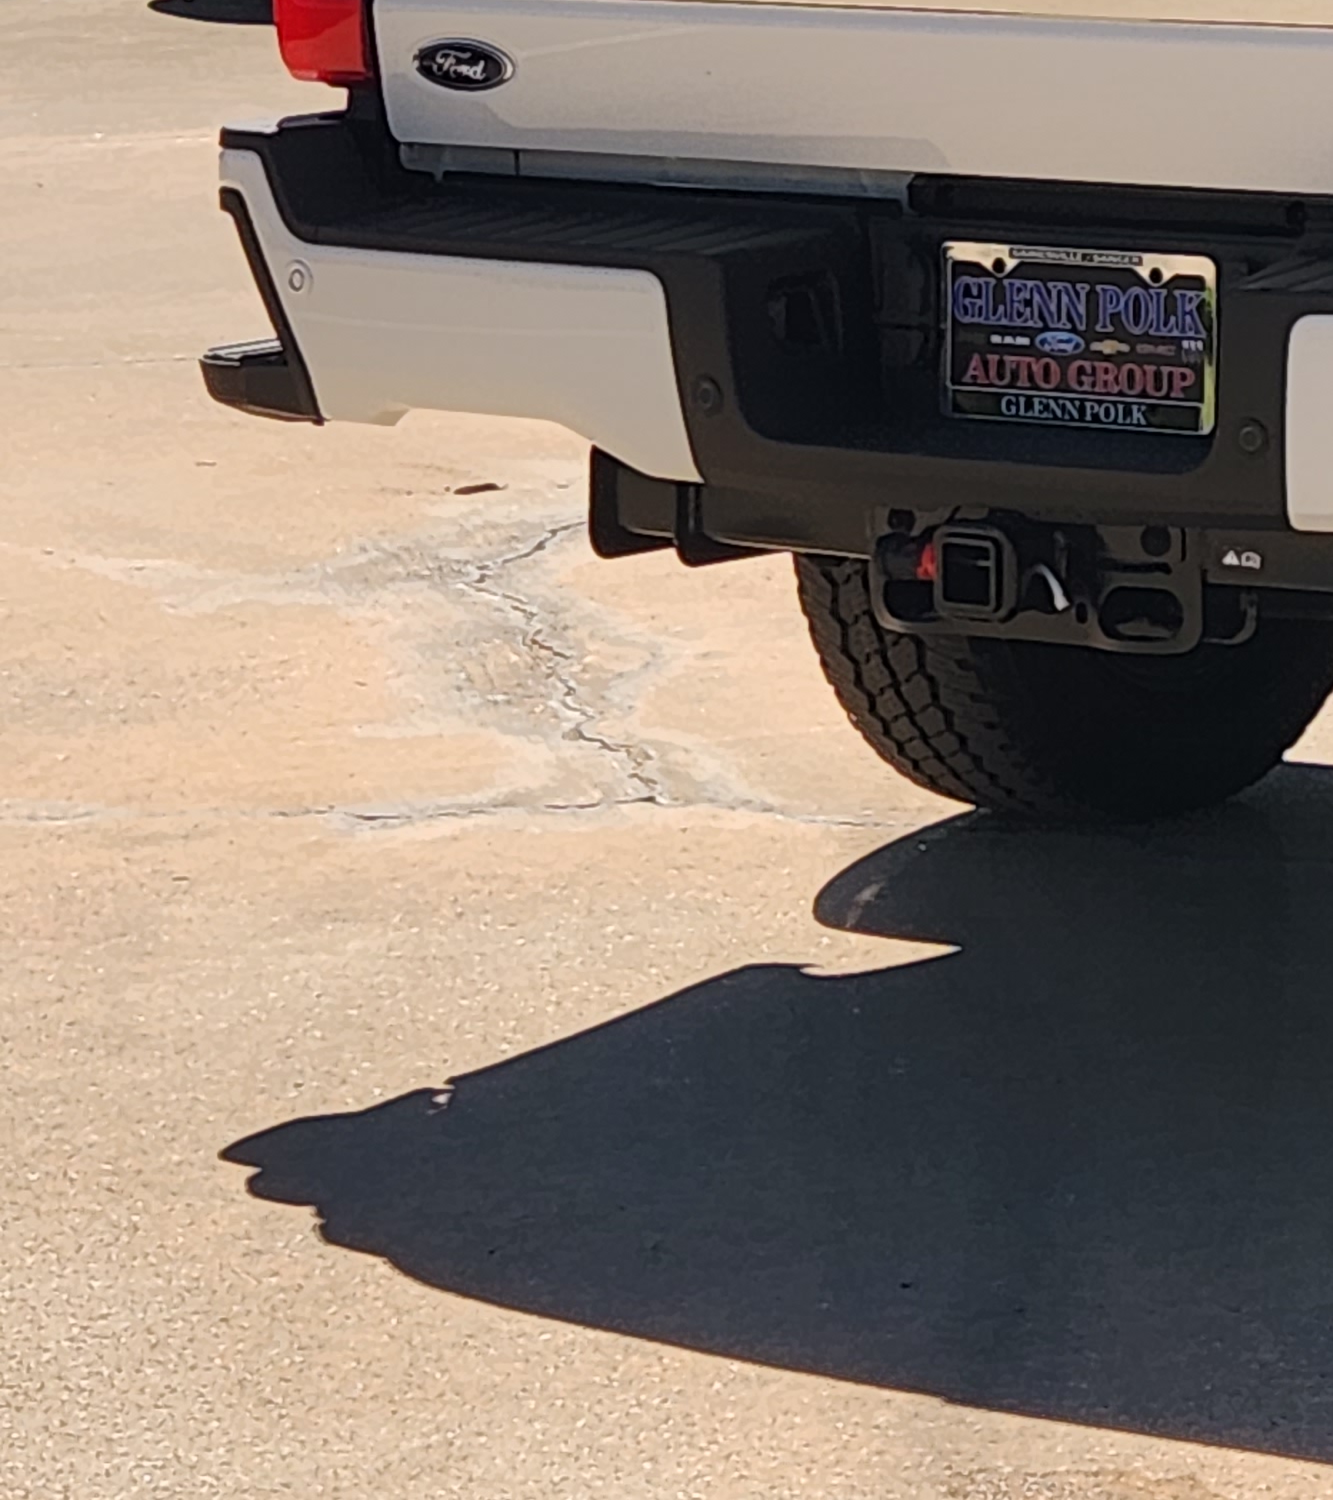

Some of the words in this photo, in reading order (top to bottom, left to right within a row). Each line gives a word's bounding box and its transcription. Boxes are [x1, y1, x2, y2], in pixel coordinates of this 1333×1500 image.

[422, 48, 487, 81] Ford
[953, 275, 1090, 331] GLENN
[1095, 283, 1207, 338] POLK
[961, 353, 1061, 389] AUTO
[1066, 359, 1196, 398] GROUP
[1000, 394, 1080, 421] GLENN
[1083, 401, 1148, 426] POLK
